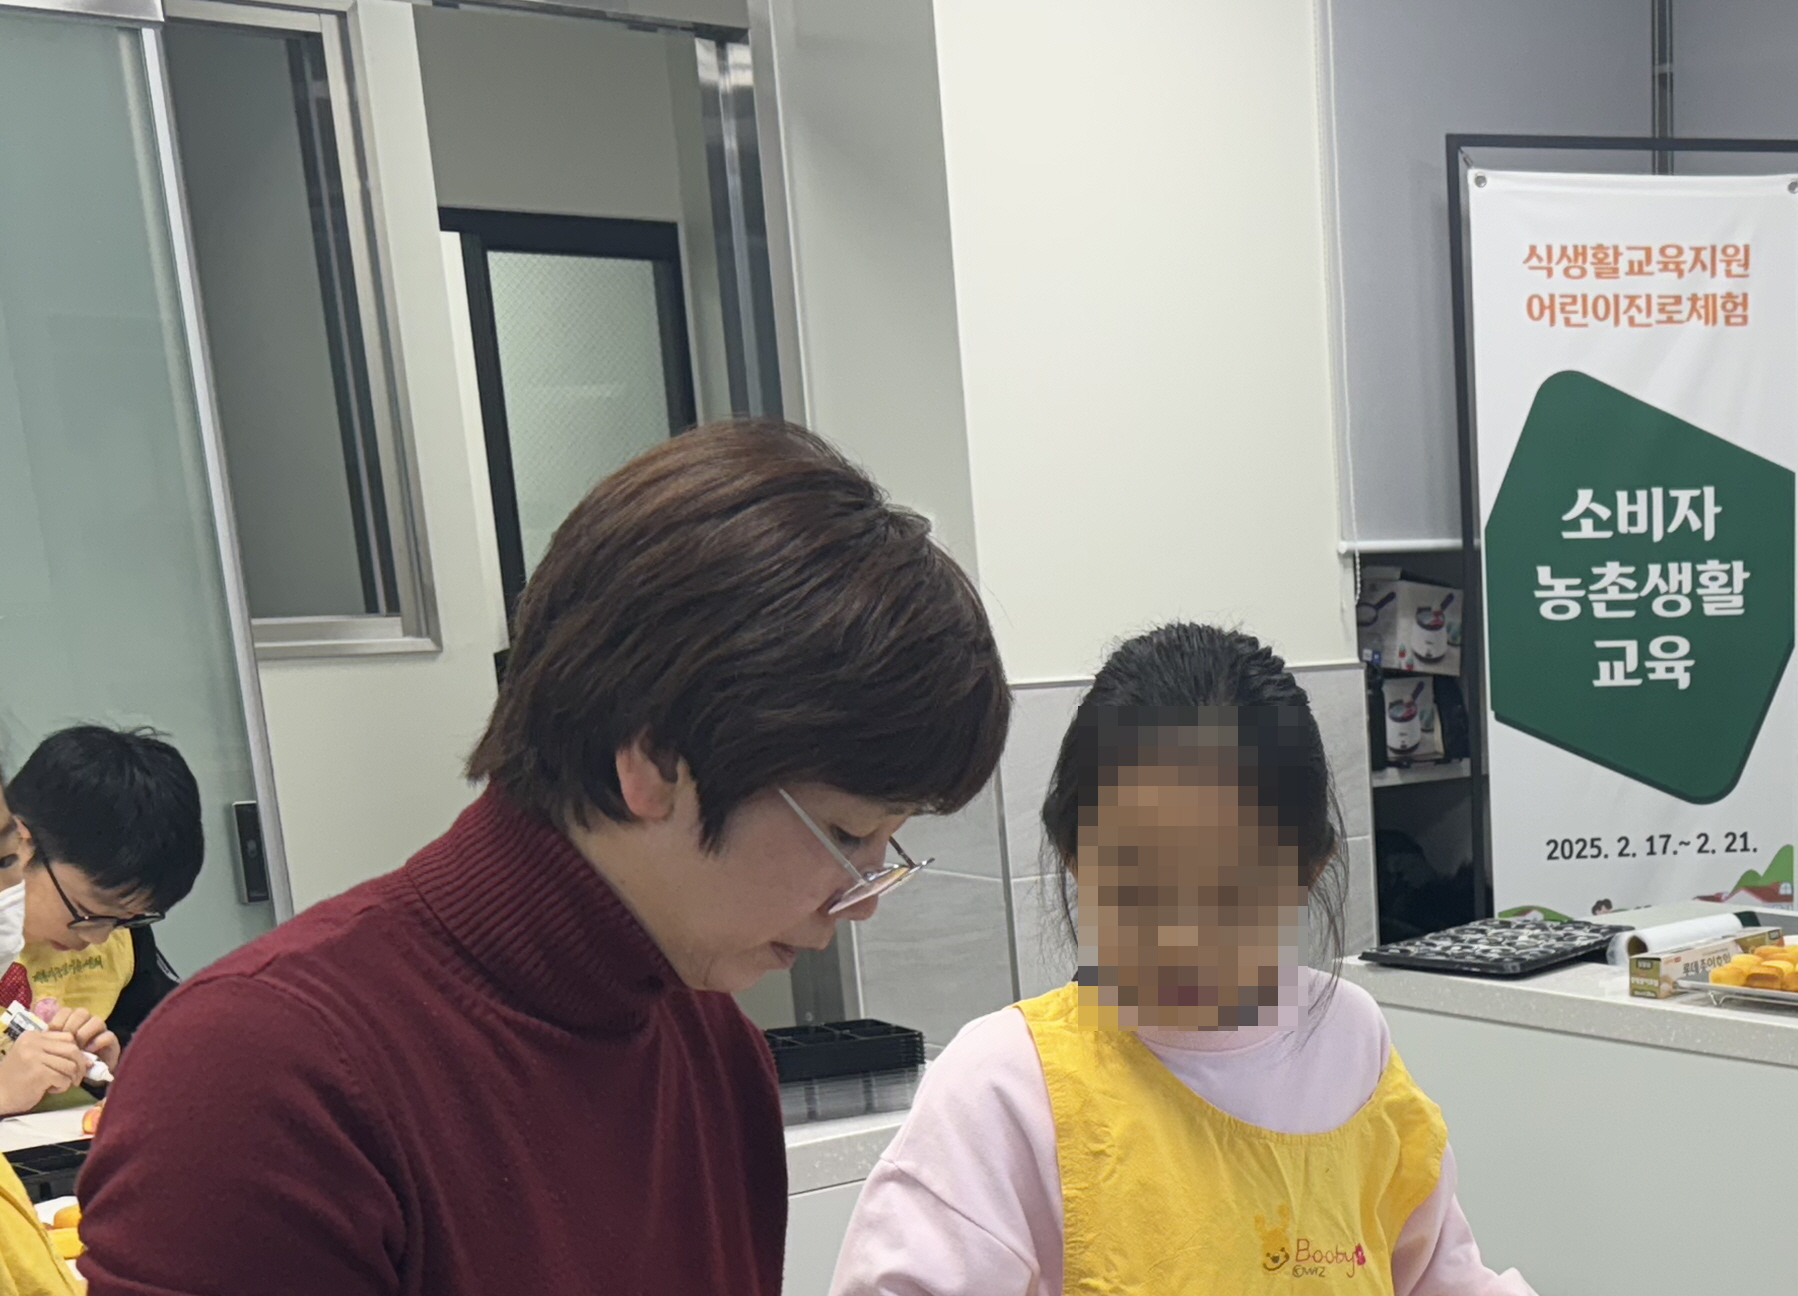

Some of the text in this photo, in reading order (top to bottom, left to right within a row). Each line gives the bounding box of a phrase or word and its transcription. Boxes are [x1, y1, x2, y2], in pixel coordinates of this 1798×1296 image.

[1523, 243, 1750, 279] 식생활교육지원
[1526, 291, 1749, 328] 어린이진로체험
[1561, 485, 1723, 543] 소비자
[1533, 559, 1751, 621] 농촌생활
[1592, 635, 1695, 690] 교육
[1546, 837, 1609, 861] 2025.
[1617, 836, 1637, 858] 2.
[1724, 831, 1758, 853] 21.
[1296, 1238, 1356, 1278] Booby
